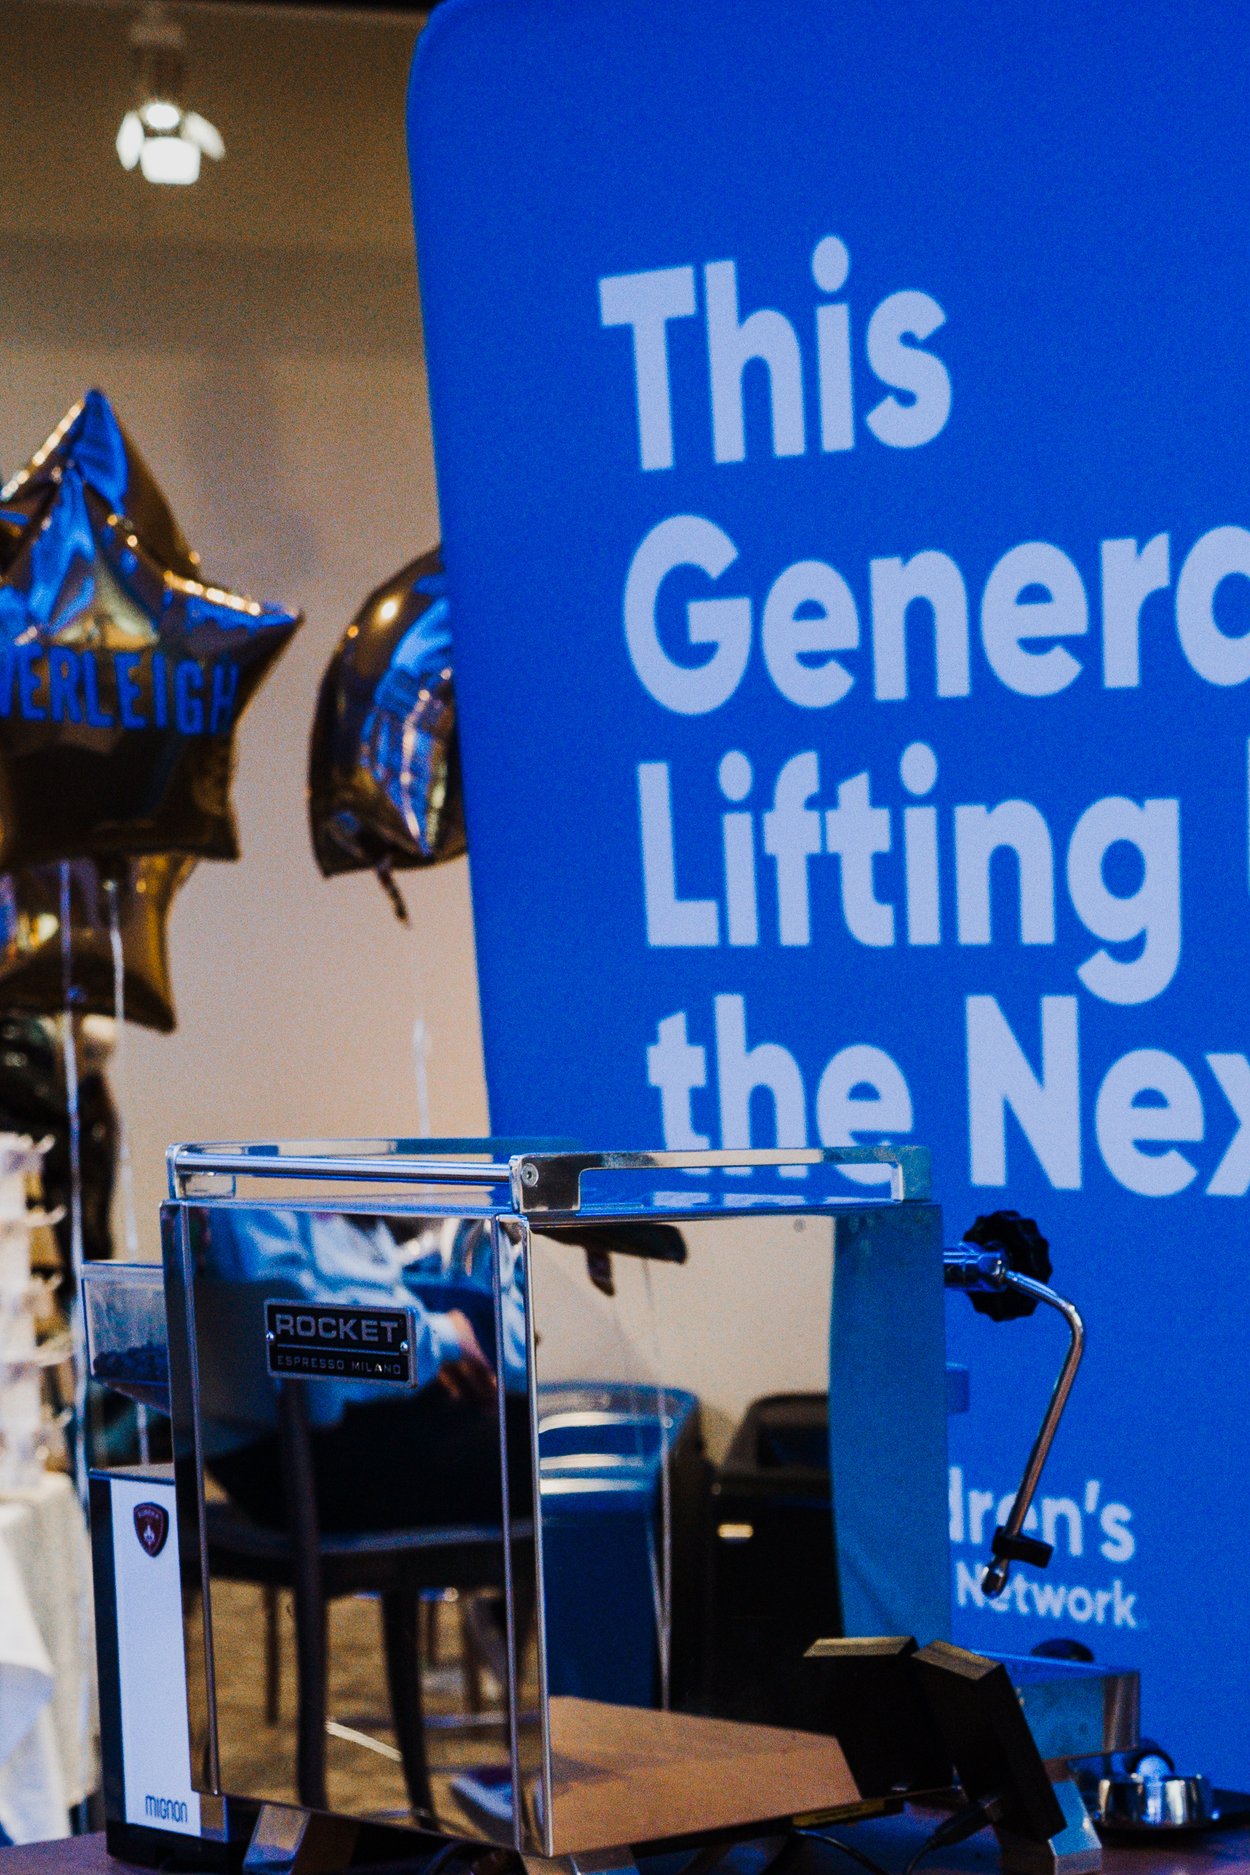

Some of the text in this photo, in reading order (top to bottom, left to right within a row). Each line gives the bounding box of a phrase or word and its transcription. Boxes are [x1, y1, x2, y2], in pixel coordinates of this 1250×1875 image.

[599, 236, 951, 471] This
[638, 742, 1181, 1004] Lifting
[647, 993, 912, 1185] the
[275, 1313, 399, 1343] ROCKET
[277, 1355, 401, 1375] ESPRESSO MILANO
